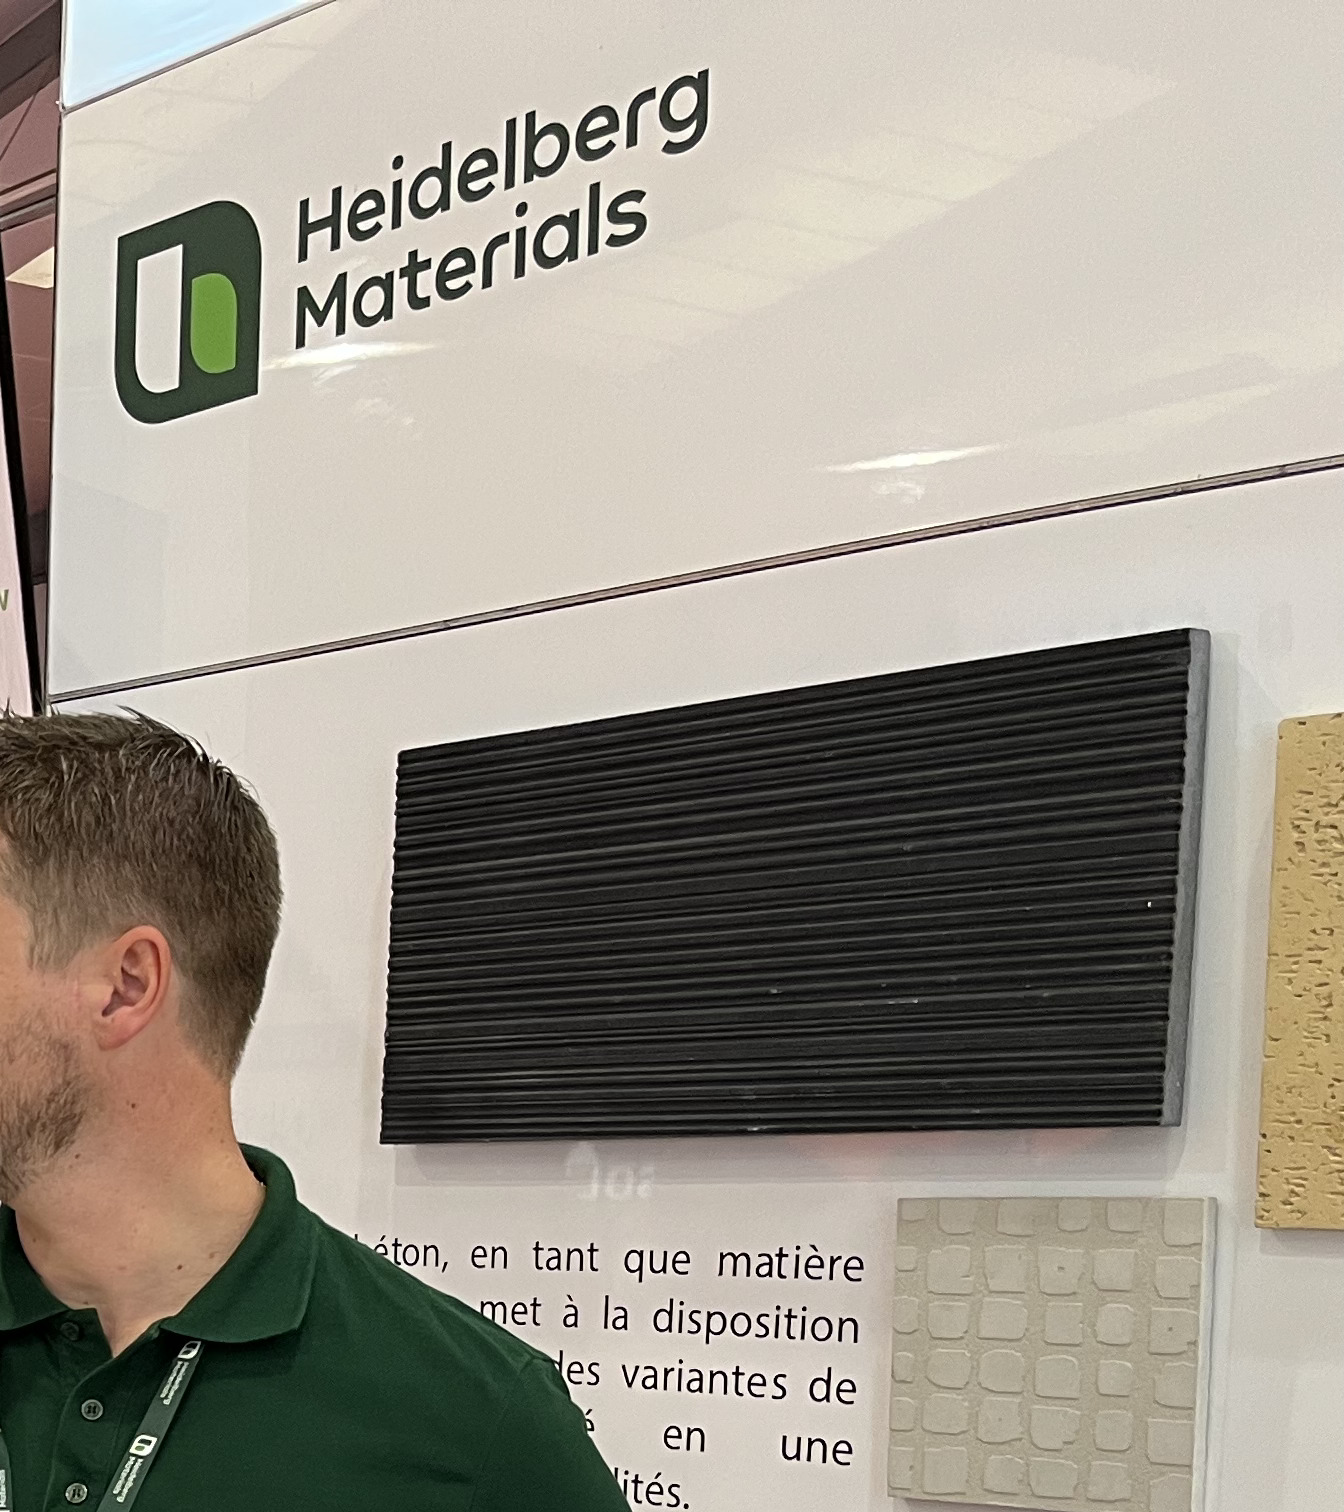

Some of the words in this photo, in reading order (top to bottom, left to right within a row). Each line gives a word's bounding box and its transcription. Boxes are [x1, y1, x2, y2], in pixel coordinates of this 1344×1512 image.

[298, 68, 710, 264] Heidelberg
[295, 181, 648, 350] Materials
[354, 1234, 449, 1274] éton,
[471, 1244, 509, 1269] en
[533, 1241, 599, 1272] tant
[623, 1246, 692, 1283] que
[717, 1245, 866, 1283] matière
[480, 1297, 542, 1326] met
[562, 1294, 579, 1328] à
[603, 1295, 629, 1331] la
[652, 1298, 861, 1346] disposition
[621, 1359, 788, 1402] variantes
[807, 1365, 858, 1406] de
[663, 1424, 706, 1453] en
[781, 1435, 855, 1468] une
